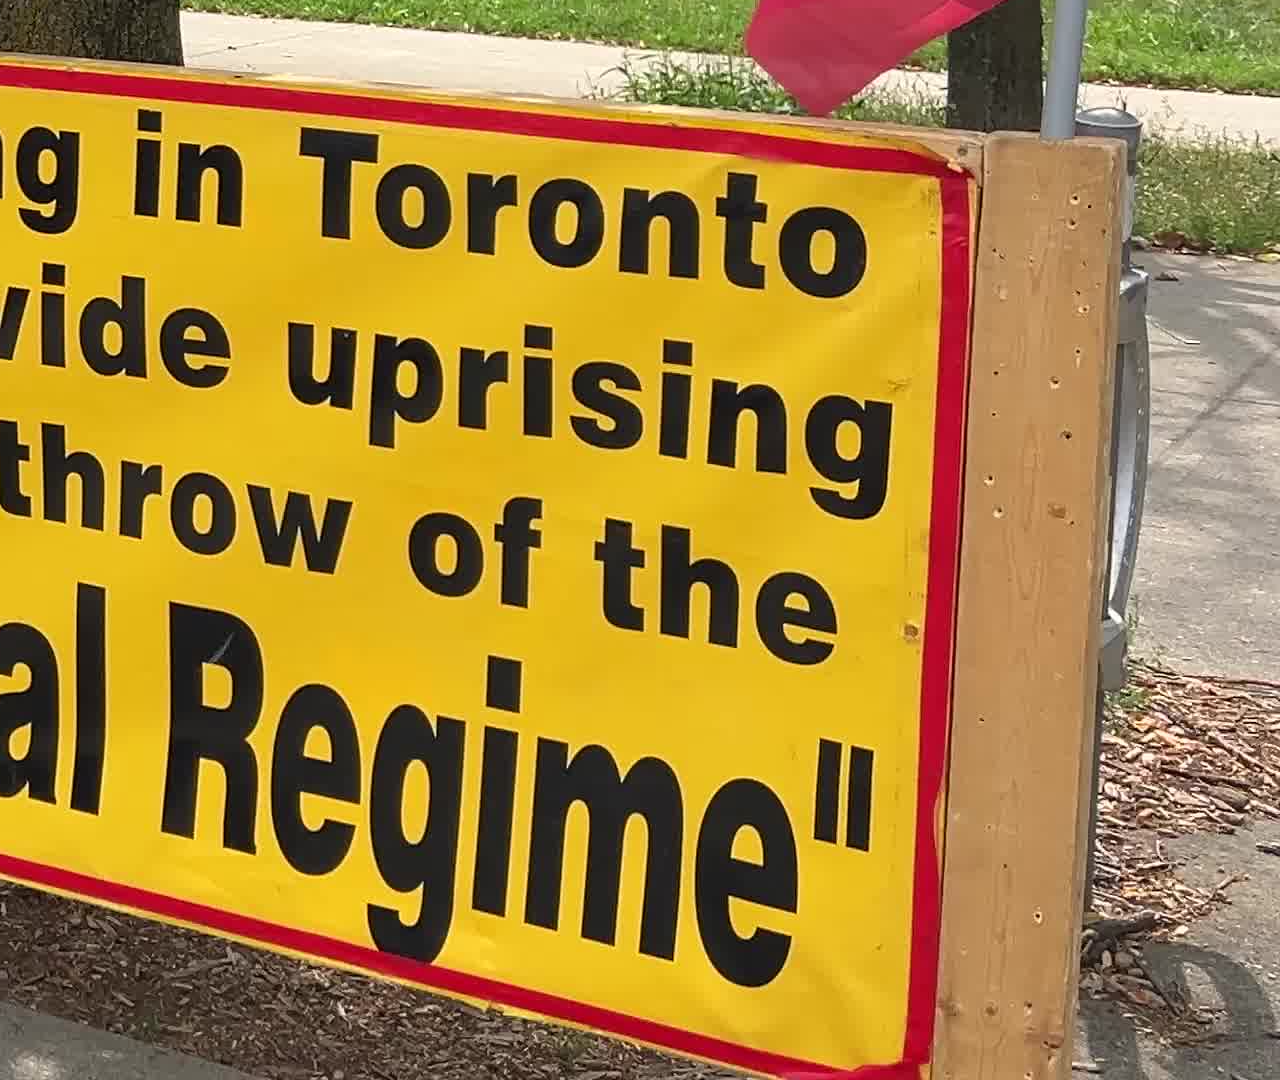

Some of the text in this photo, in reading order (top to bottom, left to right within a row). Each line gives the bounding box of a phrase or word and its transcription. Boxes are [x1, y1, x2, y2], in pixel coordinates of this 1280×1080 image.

[134, 109, 244, 228] in
[299, 127, 868, 299] Toronto
[287, 322, 894, 520] uprising
[408, 497, 543, 609] of
[594, 518, 838, 666] the
[160, 601, 874, 989] Regime"
